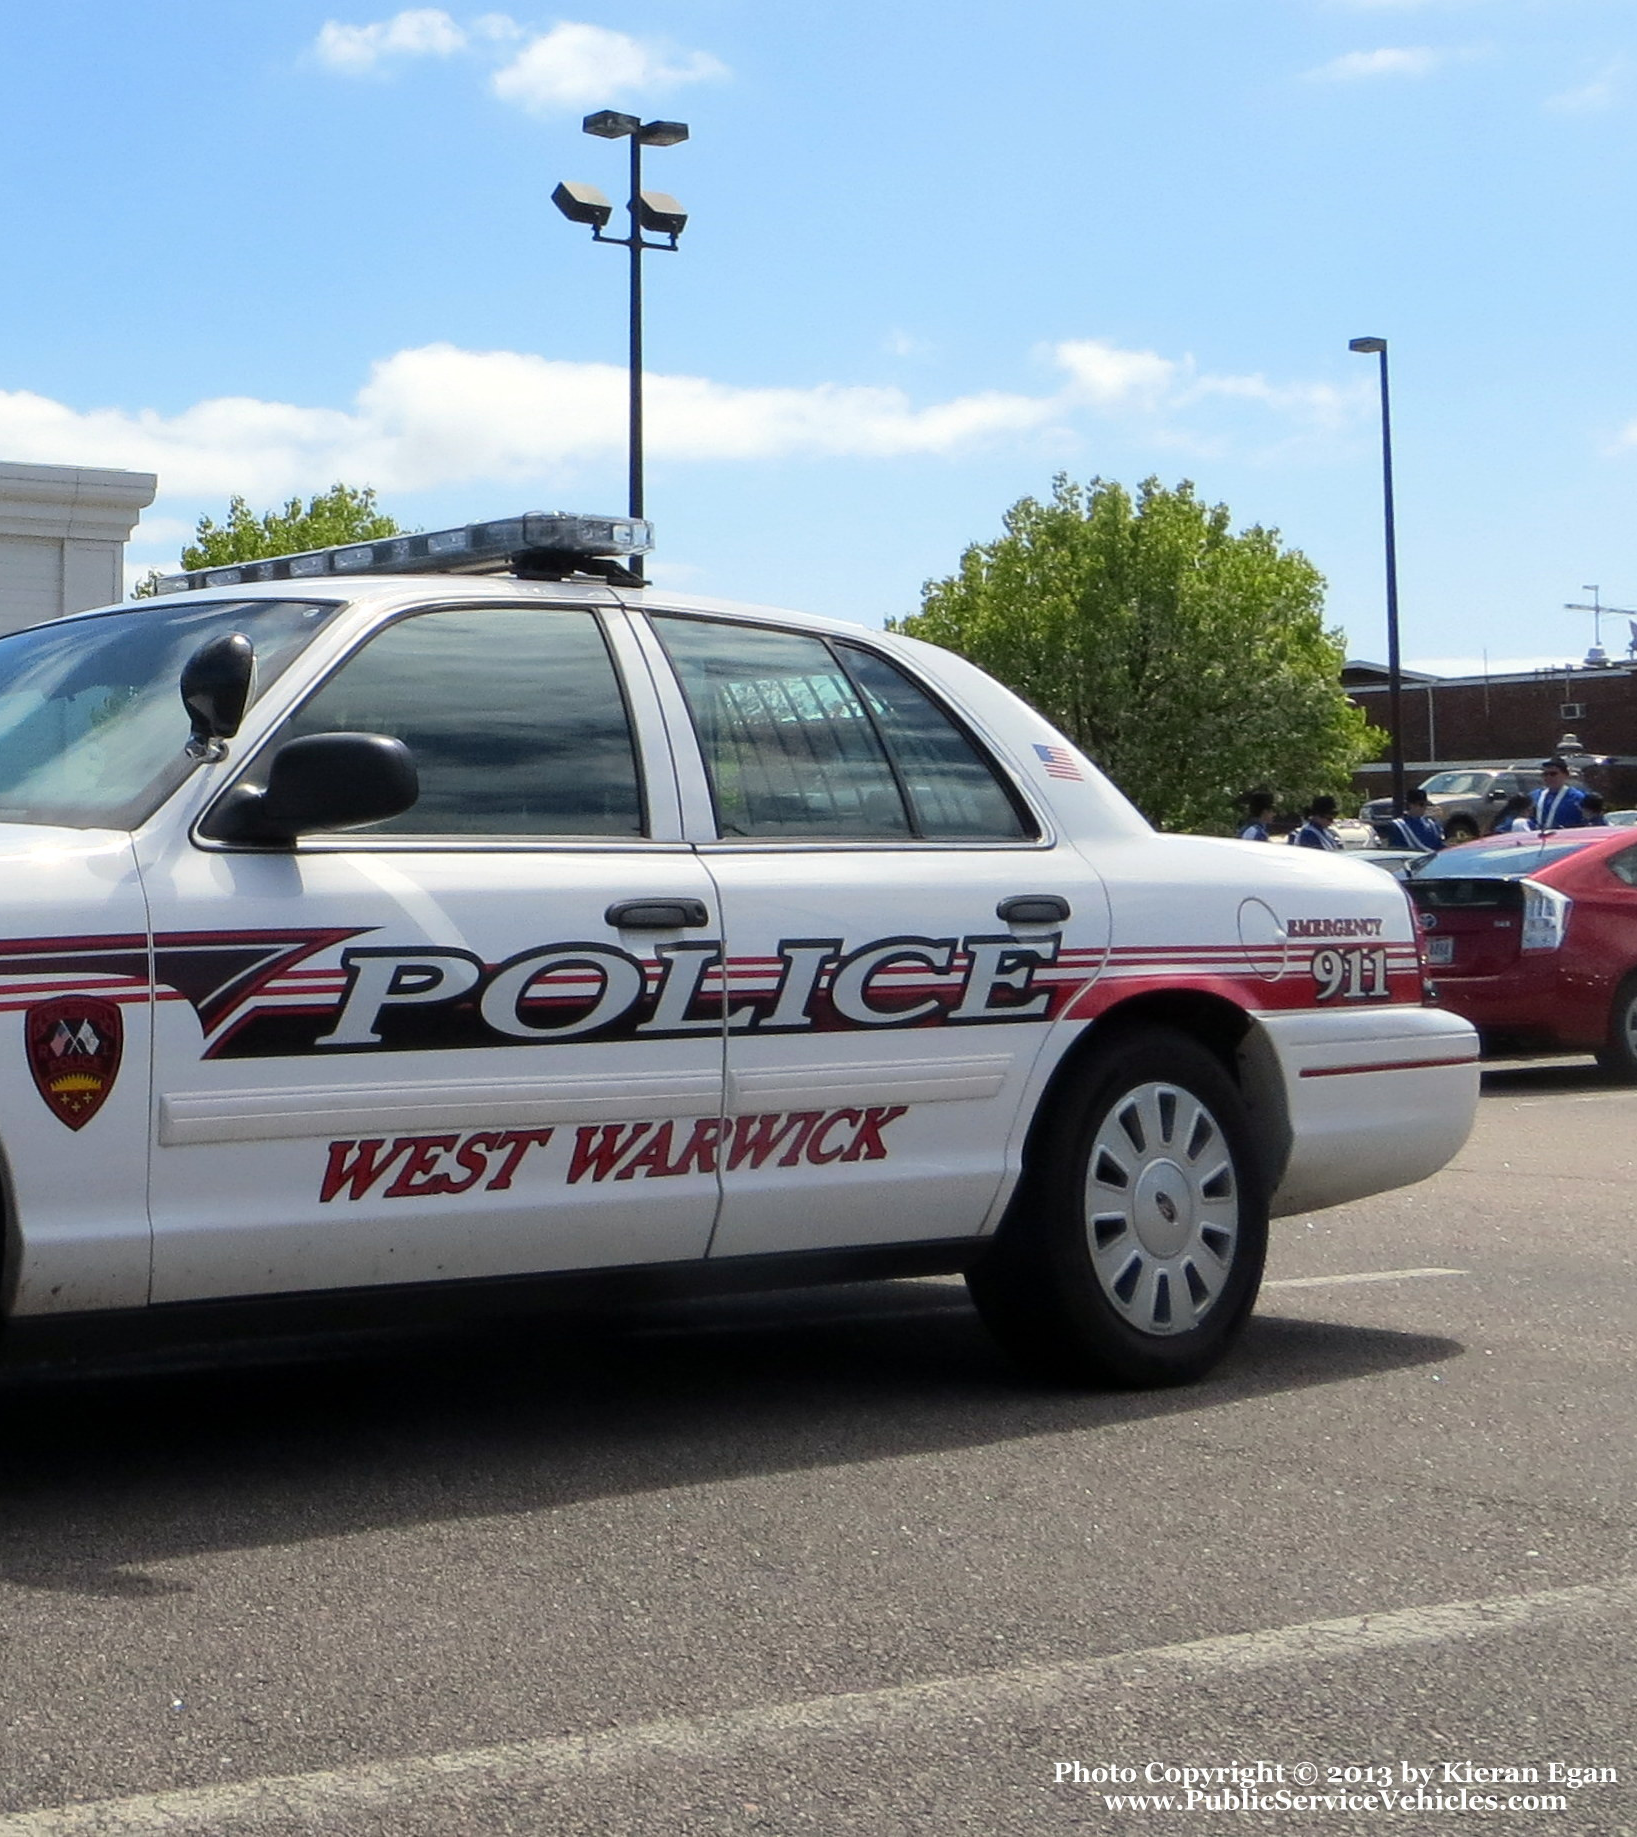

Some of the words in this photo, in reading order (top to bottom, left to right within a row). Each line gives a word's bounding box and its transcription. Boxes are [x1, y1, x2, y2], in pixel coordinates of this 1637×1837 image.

[1286, 918, 1383, 937] EMERGENCY
[313, 933, 1058, 1046] POLICE
[1312, 947, 1390, 1000] 911
[319, 1127, 555, 1202] WEST
[566, 1105, 909, 1185] WARWICK
